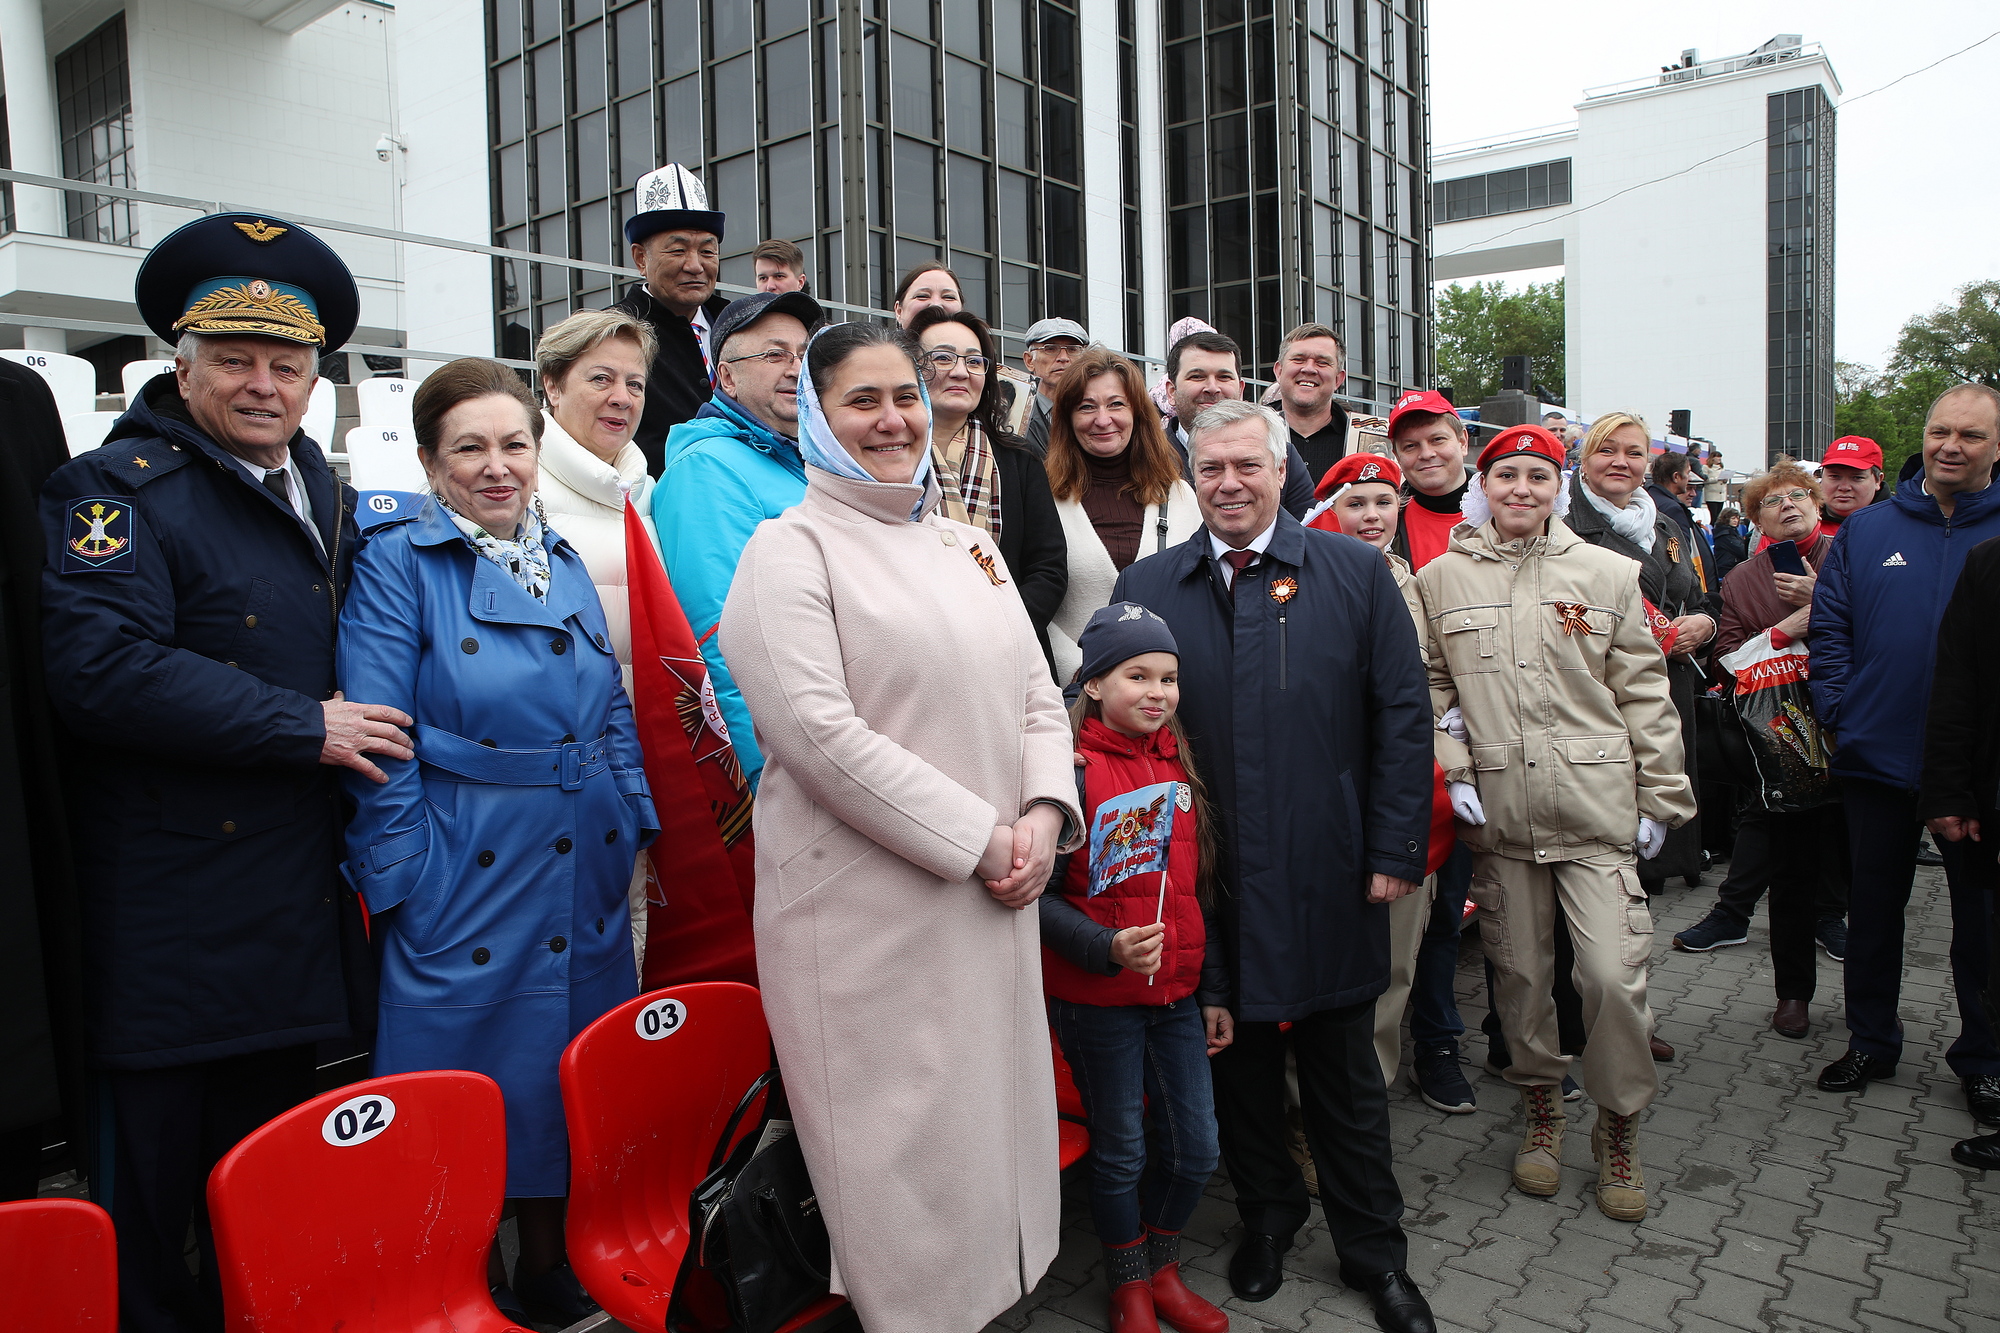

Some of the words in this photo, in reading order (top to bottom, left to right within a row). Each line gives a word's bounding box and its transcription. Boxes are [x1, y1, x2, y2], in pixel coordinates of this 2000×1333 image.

[26, 355, 47, 367] 06
[163, 365, 177, 374] 0
[390, 383, 404, 393] 09
[382, 431, 399, 442] 06
[373, 498, 394, 510] 05
[643, 1003, 679, 1036] 03
[334, 1099, 386, 1141] 02
